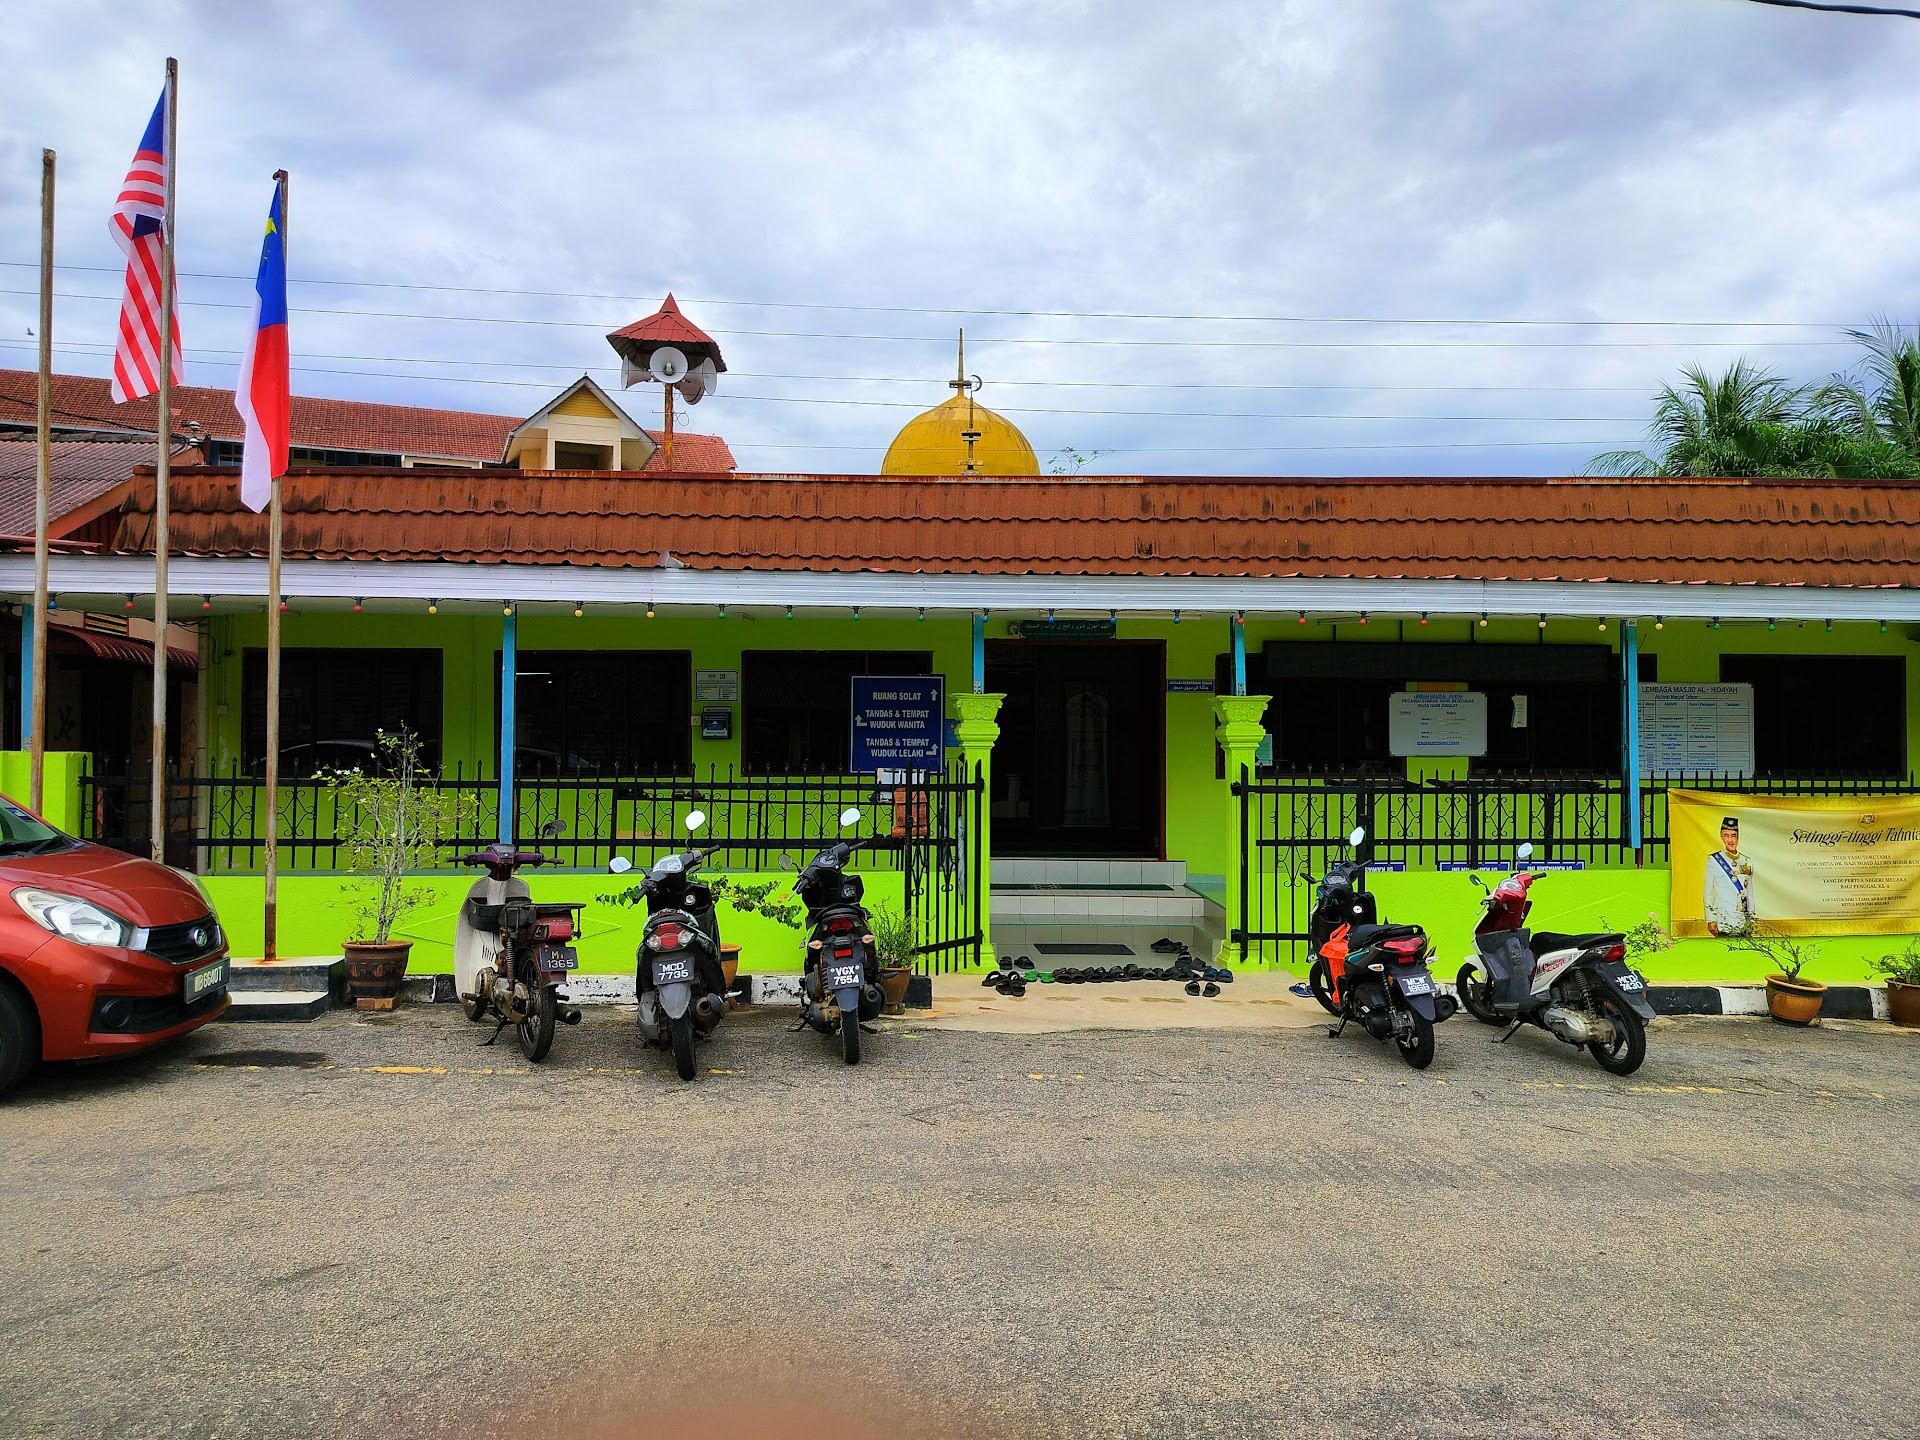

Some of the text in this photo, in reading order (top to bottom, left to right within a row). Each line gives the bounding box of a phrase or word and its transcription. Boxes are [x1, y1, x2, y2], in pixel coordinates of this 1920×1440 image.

[872, 692, 897, 700] RUANG
[871, 749, 897, 757] WUDUK
[1789, 828, 1883, 847] Setinggi-tinggi
[547, 960, 574, 968] 1365
[662, 962, 684, 972] MCD
[658, 970, 688, 980] 7735
[836, 966, 855, 976] VGX
[834, 974, 859, 985] 7554
[1620, 982, 1643, 991] 7430
